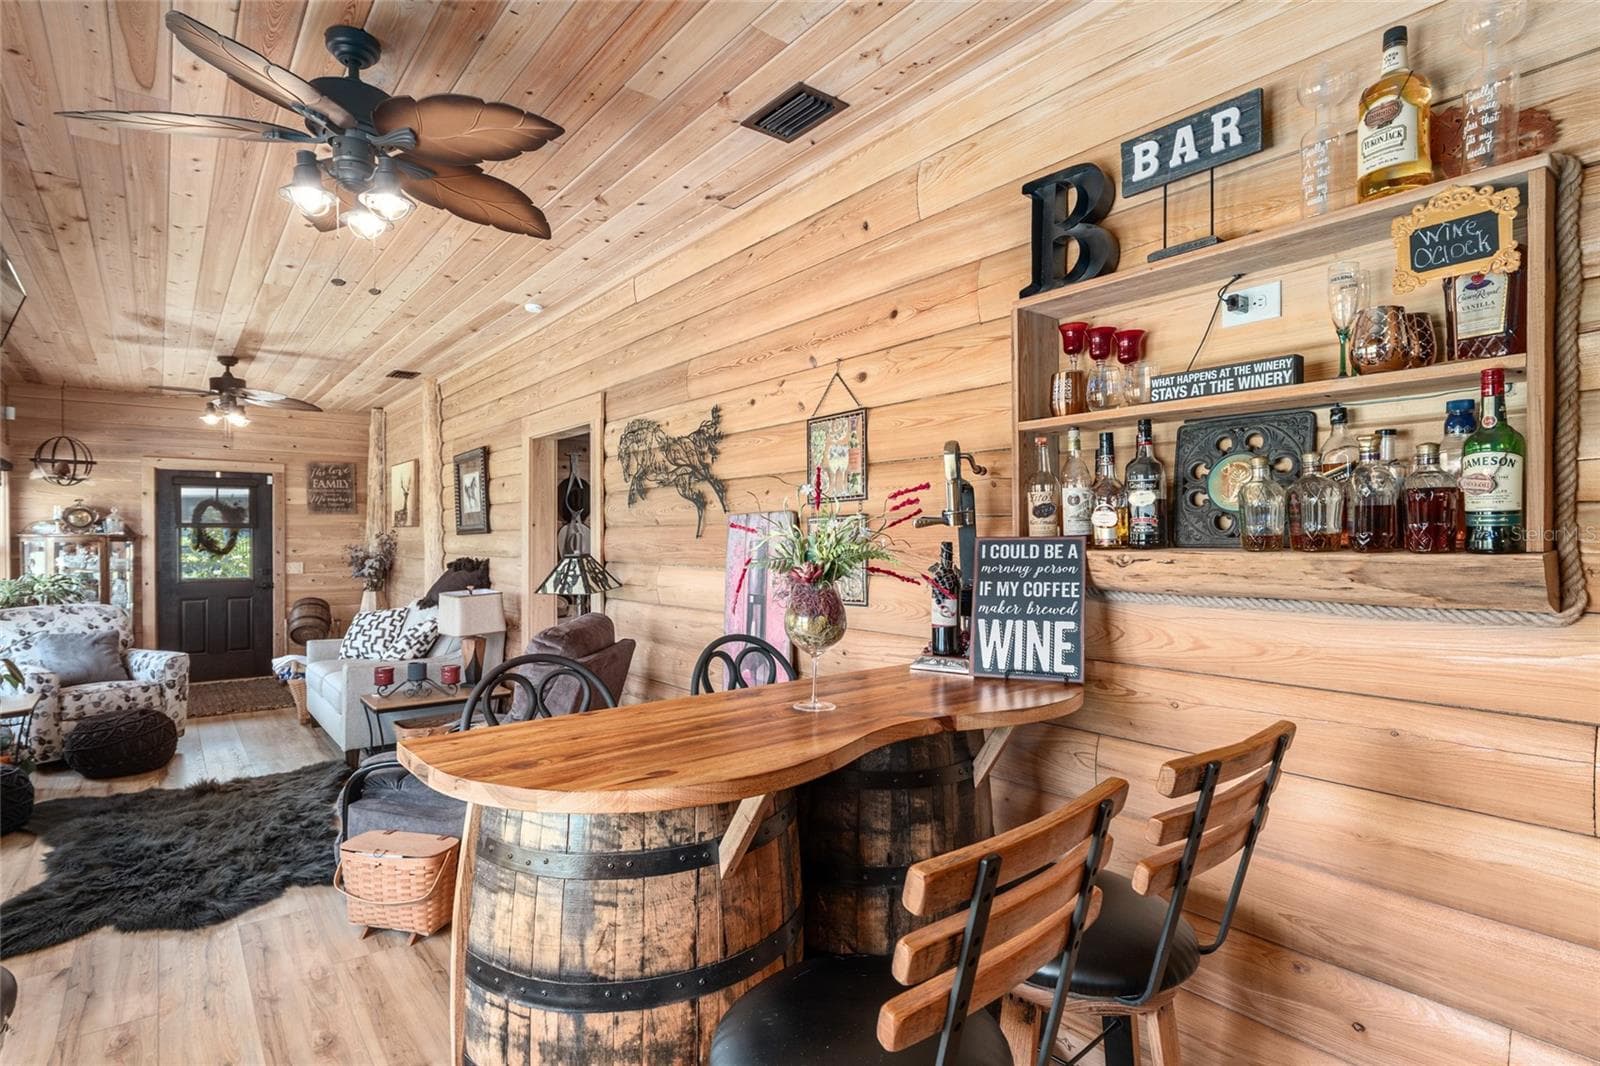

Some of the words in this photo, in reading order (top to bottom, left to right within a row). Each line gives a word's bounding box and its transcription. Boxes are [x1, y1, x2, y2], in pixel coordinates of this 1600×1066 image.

[1480, 111, 1501, 126] that
[1131, 106, 1243, 183] BAR
[1019, 162, 1121, 299] B
[1461, 300, 1496, 312] VANILLA
[1151, 376, 1174, 388] WHAT
[1176, 370, 1217, 385] HAPPENS
[1219, 367, 1231, 378] AT
[1233, 364, 1251, 375] THE
[1253, 357, 1293, 373] WINERY
[1151, 387, 1188, 401] STAYS
[1190, 383, 1206, 396] AT
[1210, 378, 1234, 394] THE
[1238, 370, 1292, 390] WINERY
[1463, 455, 1517, 470] JAMESON
[312, 479, 351, 489] FAMILY
[981, 544, 986, 559] I
[990, 544, 1039, 559] COULD
[1044, 544, 1064, 559] BE
[1067, 544, 1078, 559] A
[981, 564, 1032, 578] morning
[1033, 564, 1078, 578] person
[979, 581, 992, 596] IF
[996, 581, 1019, 596] MY
[1023, 582, 1080, 597] COFFEE
[978, 600, 1021, 614] maker
[1026, 601, 1078, 615] brewed
[977, 618, 1078, 675] WINE
